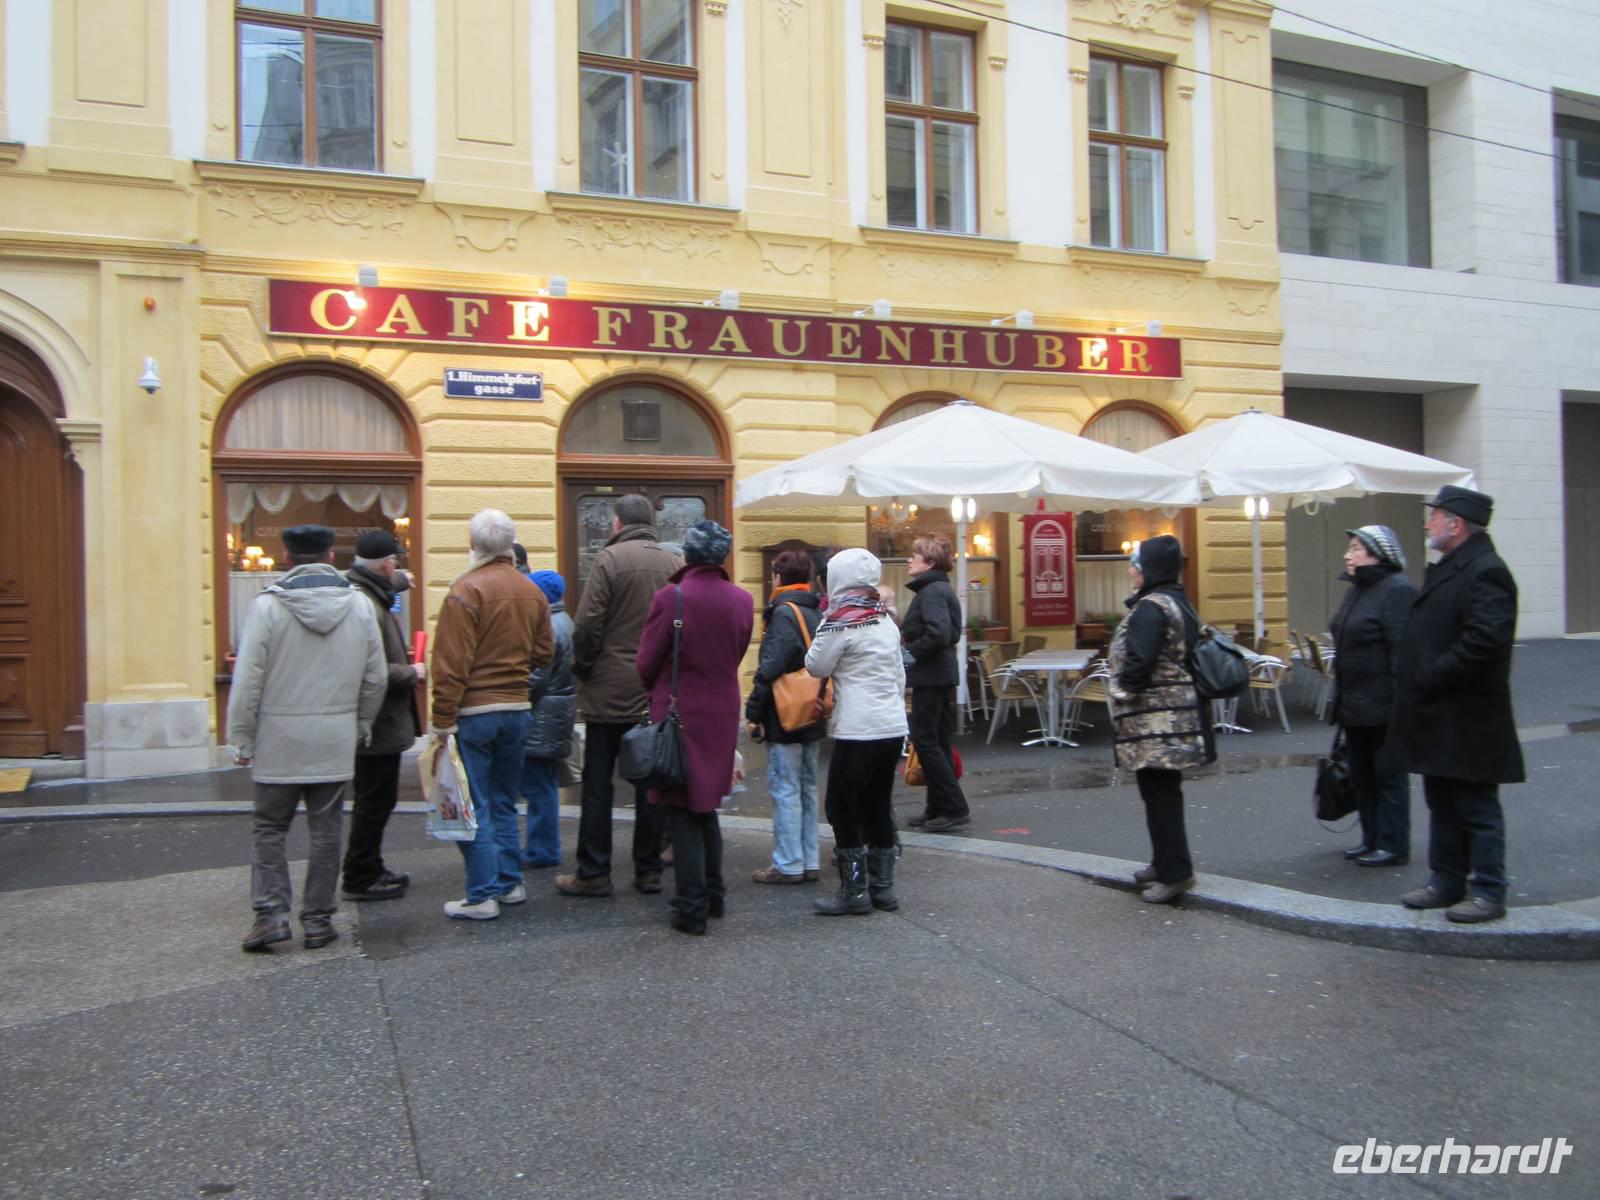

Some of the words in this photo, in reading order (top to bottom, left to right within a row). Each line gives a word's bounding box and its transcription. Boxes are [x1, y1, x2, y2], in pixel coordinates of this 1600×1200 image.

[308, 287, 550, 342] CAFE
[591, 306, 1153, 373] FRAUENHUBER
[474, 385, 515, 395] gasse
